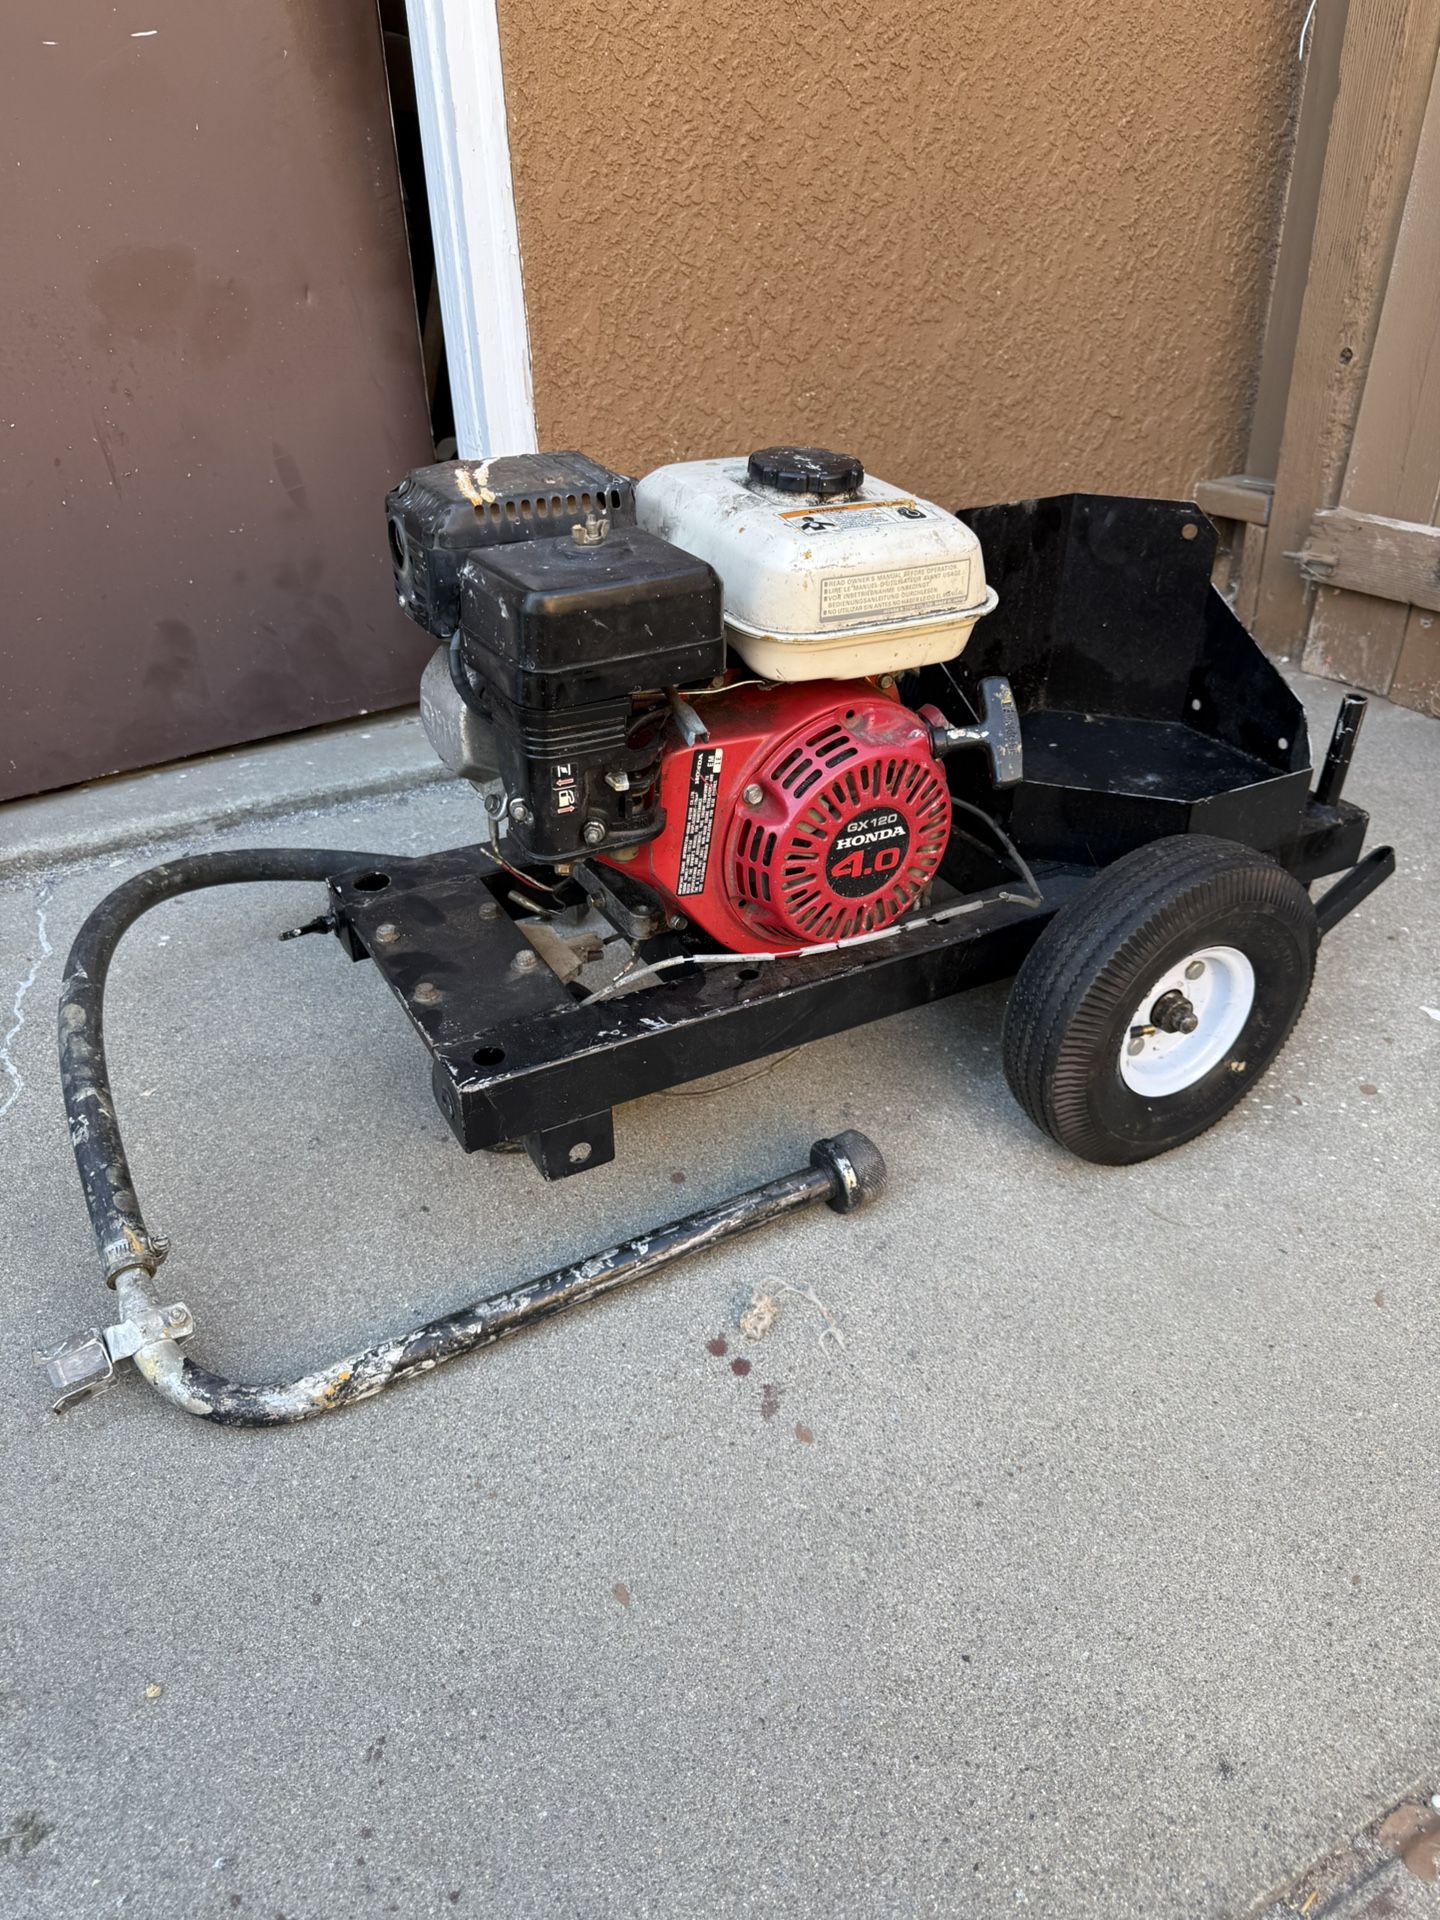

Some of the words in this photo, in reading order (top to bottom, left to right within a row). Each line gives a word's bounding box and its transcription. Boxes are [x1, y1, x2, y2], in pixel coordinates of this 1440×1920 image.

[829, 579, 845, 588] READ
[836, 826, 906, 850] HONDA
[831, 847, 900, 878] 4.0
